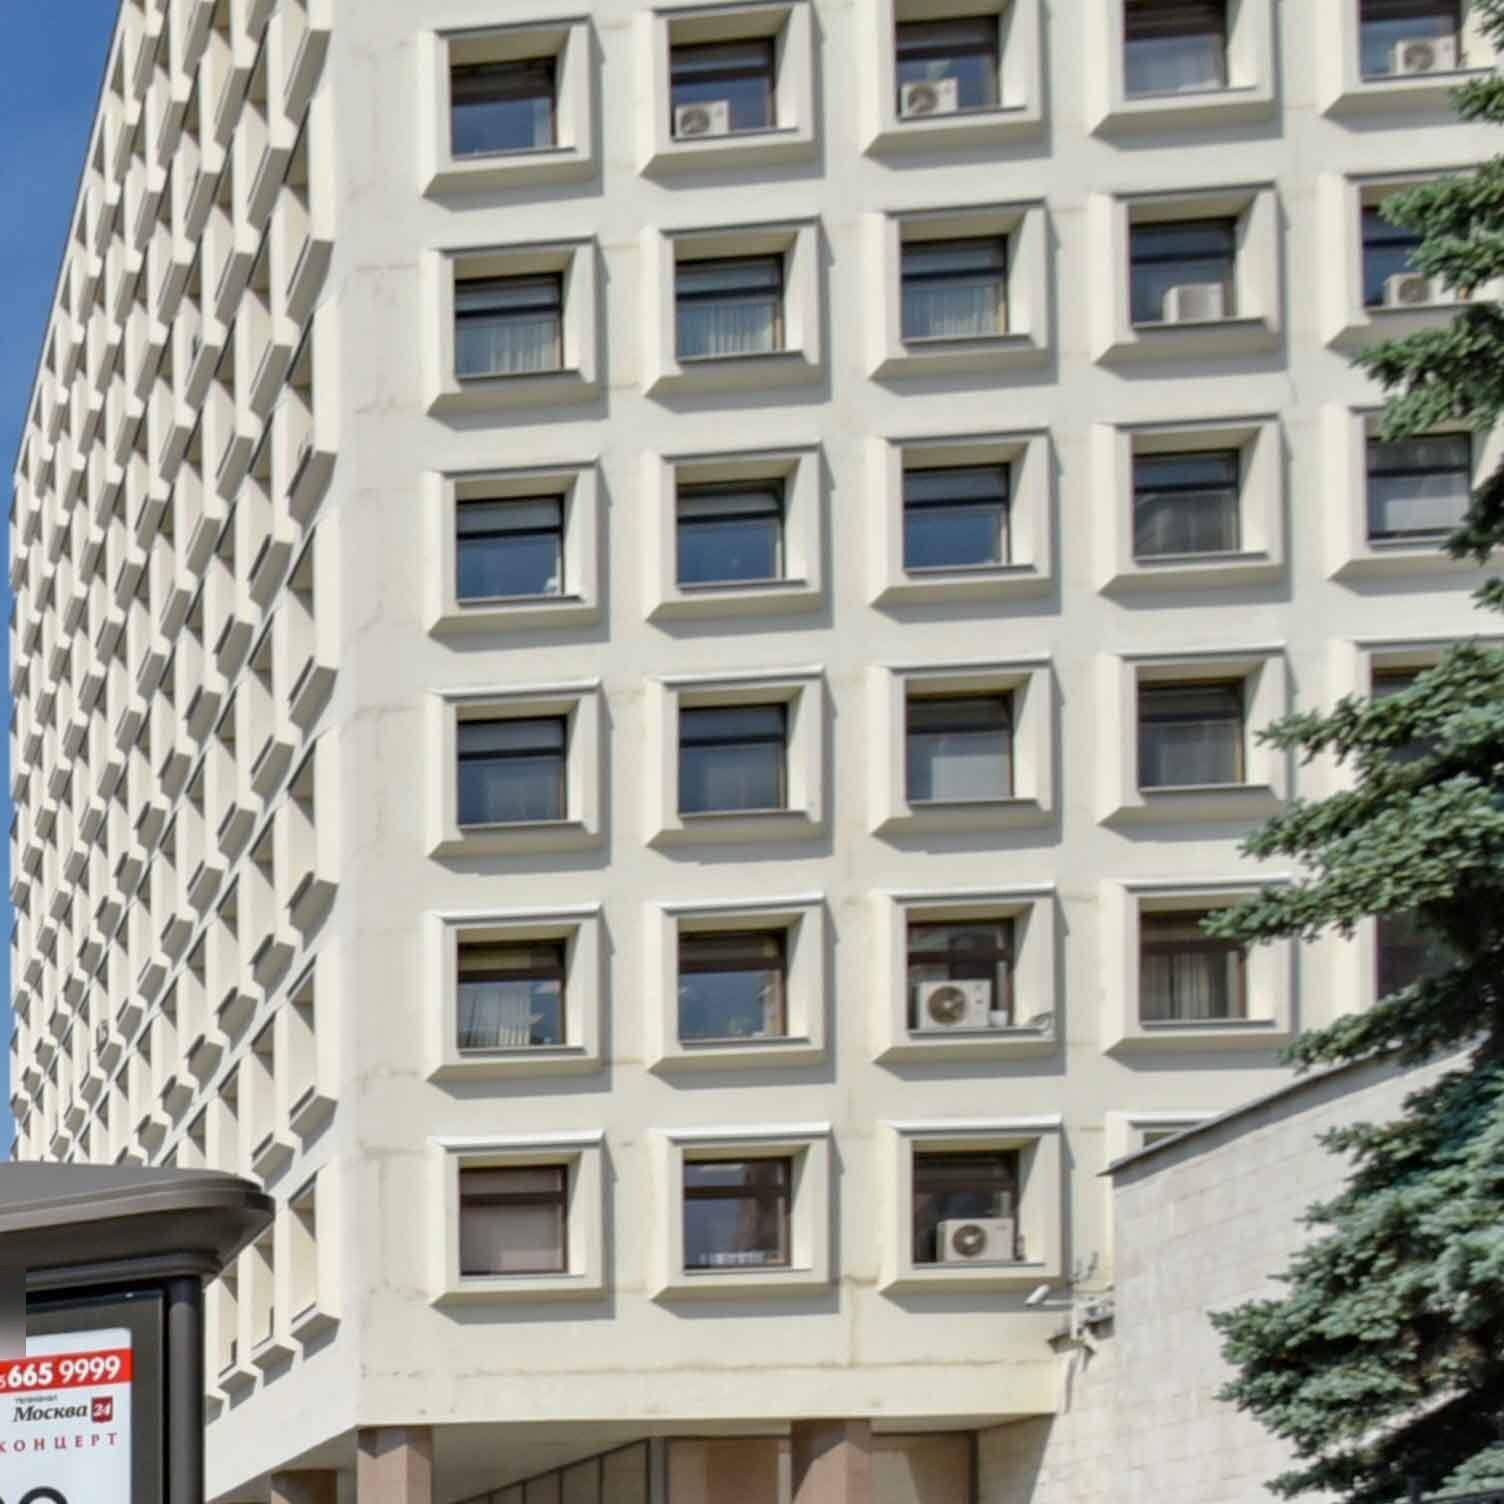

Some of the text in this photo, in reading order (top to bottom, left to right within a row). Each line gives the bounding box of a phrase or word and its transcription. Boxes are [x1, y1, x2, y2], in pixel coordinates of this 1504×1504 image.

[59, 1355, 121, 1384] 9999
[13, 1403, 112, 1423] Москва 24
